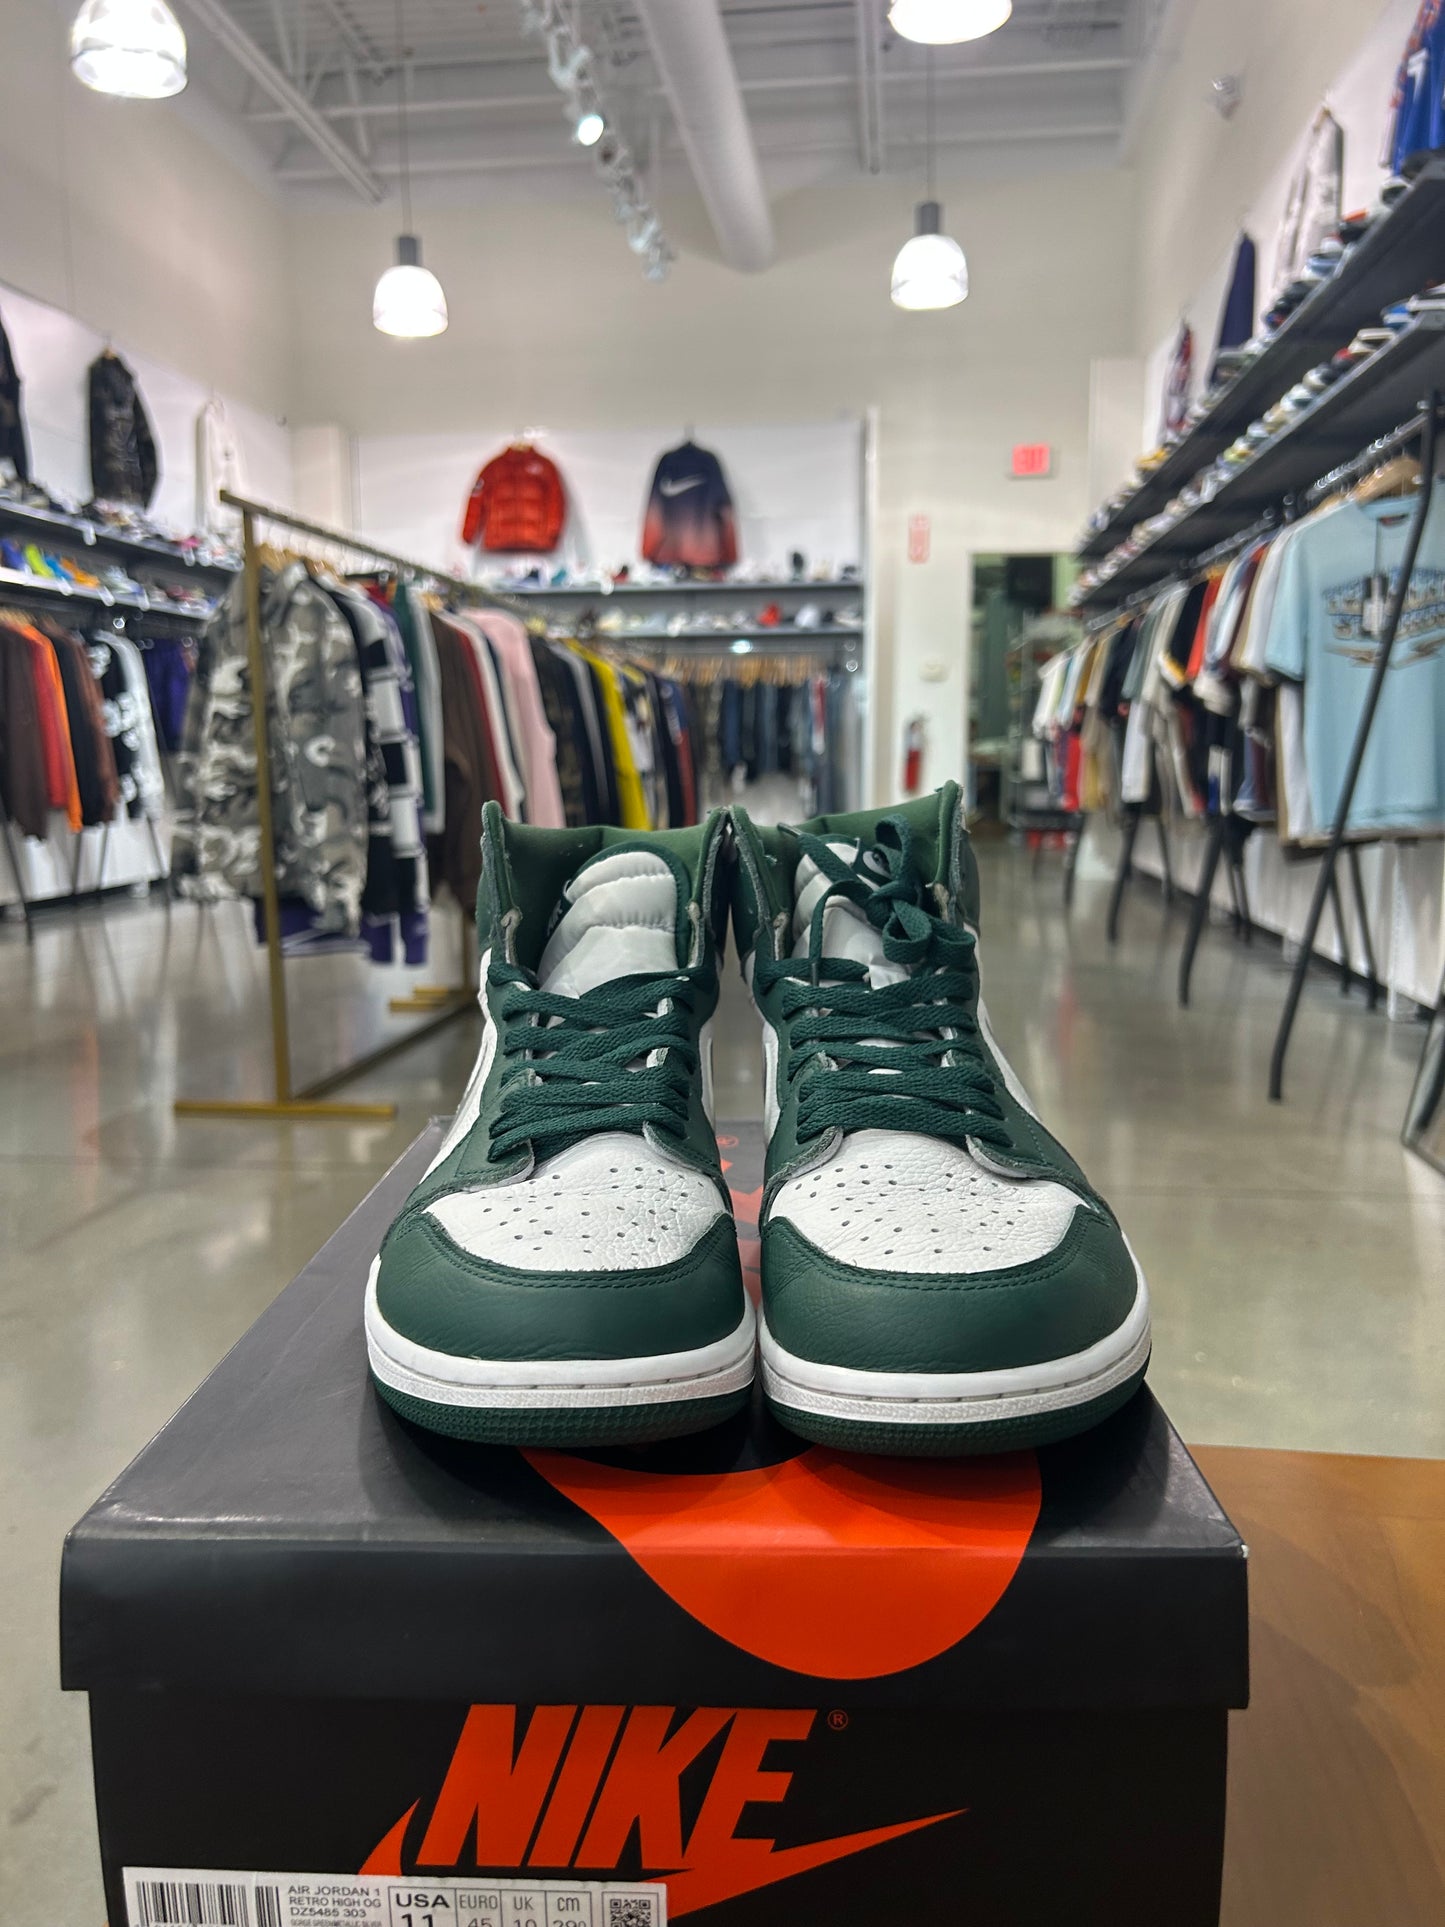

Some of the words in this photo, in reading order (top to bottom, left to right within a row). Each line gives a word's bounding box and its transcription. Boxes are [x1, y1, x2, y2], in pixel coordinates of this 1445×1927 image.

[416, 1704, 817, 1870] NIKE
[288, 1885, 310, 1895] AIR
[314, 1886, 370, 1896] JORDAN
[374, 1887, 380, 1896] 1
[289, 1896, 329, 1906] RETRO
[332, 1897, 360, 1907] HIGH
[363, 1898, 382, 1908] OG
[396, 1893, 450, 1909] USA
[459, 1894, 499, 1909] EURO
[513, 1896, 534, 1911] UK
[290, 1906, 340, 1917] DZ5485
[343, 1907, 367, 1918] 303
